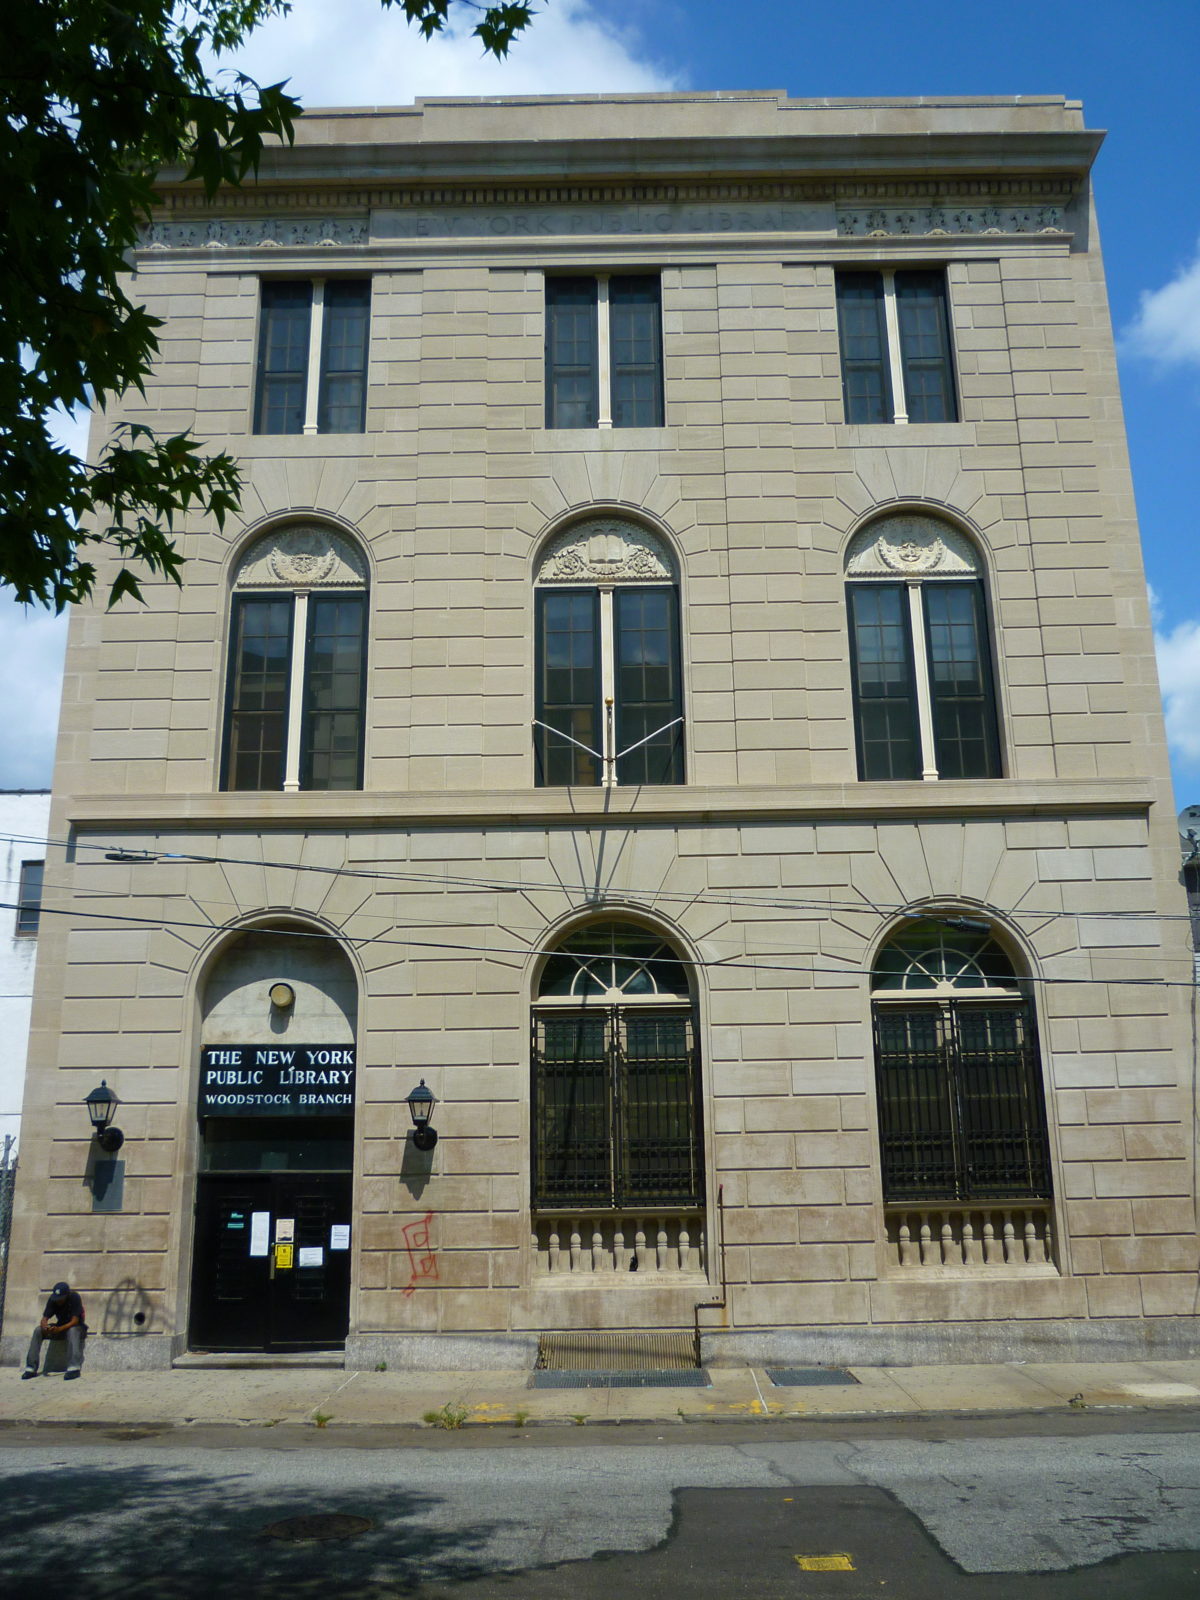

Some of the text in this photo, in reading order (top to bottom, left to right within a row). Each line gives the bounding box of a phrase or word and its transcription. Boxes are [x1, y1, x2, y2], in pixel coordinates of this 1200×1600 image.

[472, 215, 554, 235] YORK
[571, 213, 674, 233] PUBLIC
[688, 211, 817, 231] LIBRARY
[207, 1050, 354, 1065] THE NEW YORK
[206, 1070, 353, 1085] PUBLIC LIBRARY
[205, 1094, 352, 1104] WOODSTOCK BRANCH
